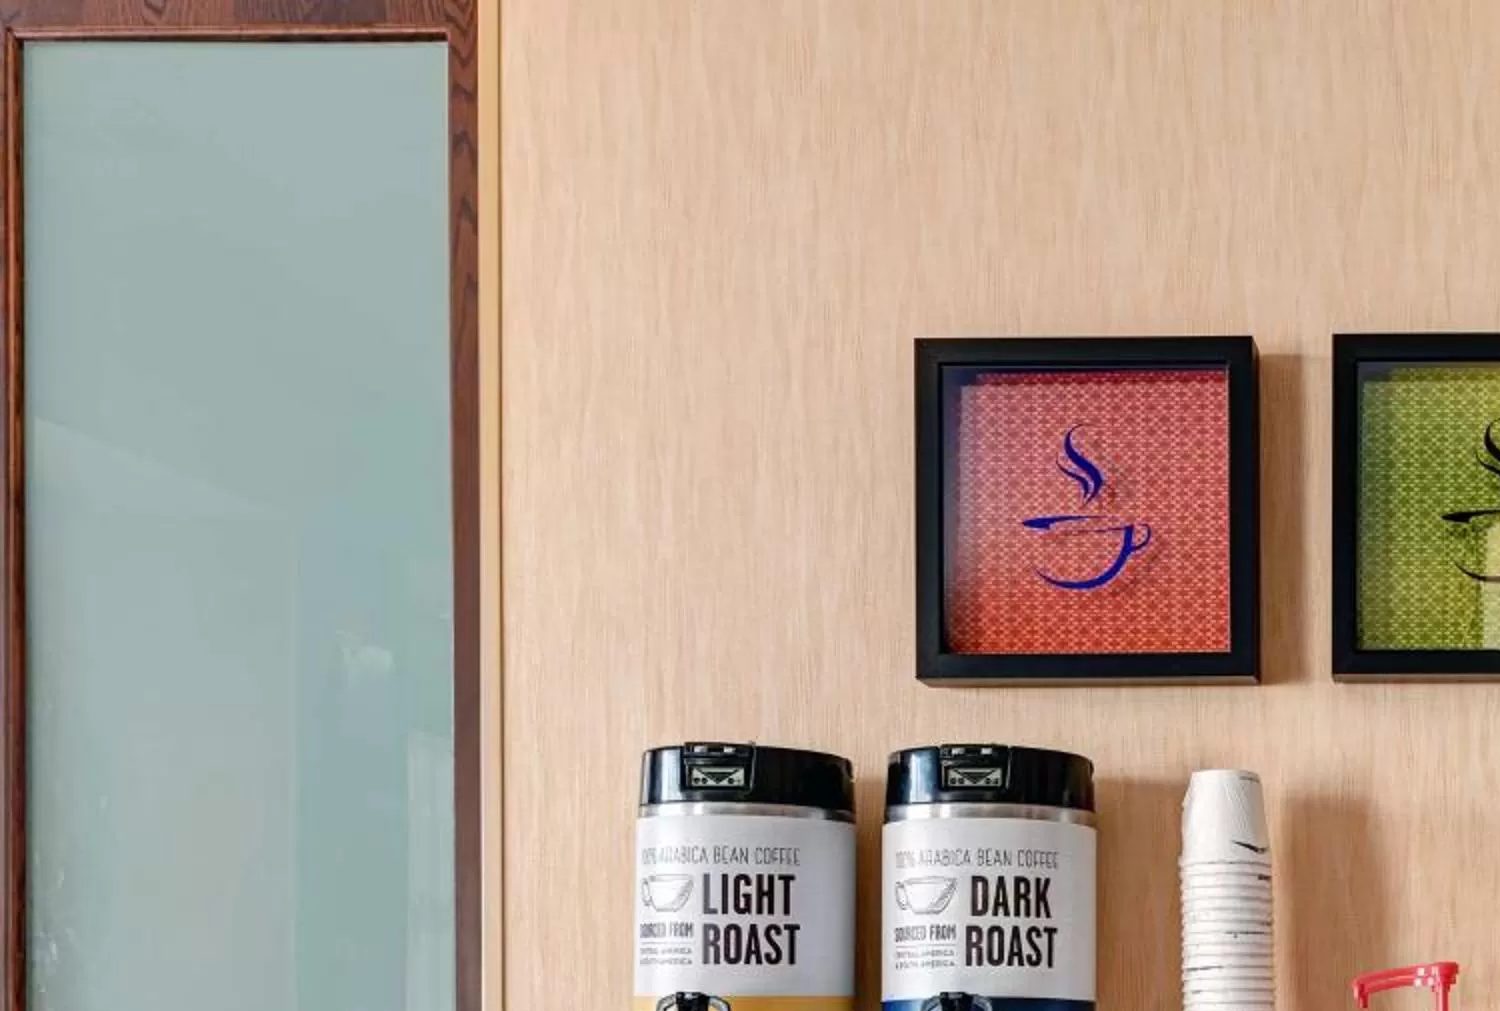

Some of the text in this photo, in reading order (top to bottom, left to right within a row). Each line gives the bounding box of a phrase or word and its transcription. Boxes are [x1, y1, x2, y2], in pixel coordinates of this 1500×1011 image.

[713, 845, 749, 865] BEAN
[754, 847, 801, 866] COFFEE
[976, 847, 1013, 867] BEAN
[1017, 849, 1059, 869] COFFEE
[702, 872, 796, 915] LIGHT
[970, 875, 1052, 918] DARK
[702, 922, 801, 965] ROAST
[929, 924, 957, 941] FROM
[965, 925, 1058, 968] ROAST
